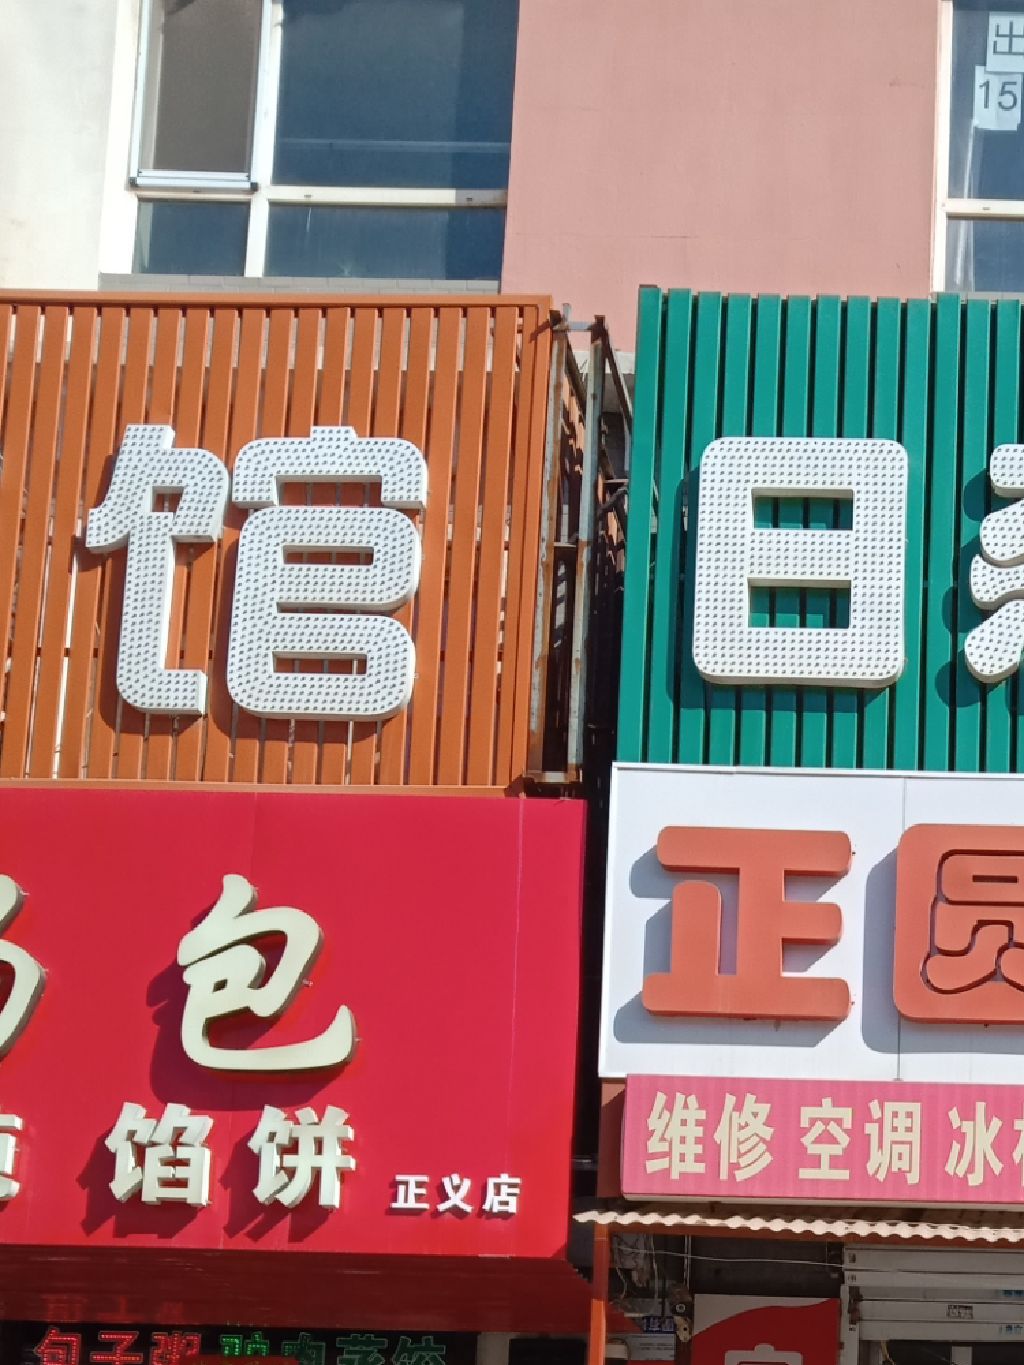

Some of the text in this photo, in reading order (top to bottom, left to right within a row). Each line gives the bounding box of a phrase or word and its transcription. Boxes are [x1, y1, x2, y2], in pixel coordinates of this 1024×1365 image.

[978, 81, 1018, 112] 15
[86, 425, 427, 721] 馆
[0, 873, 358, 1072] 包
[0, 1100, 356, 1210] 馅饼
[645, 1091, 775, 1183] 维修
[798, 1097, 922, 1186] 空调
[390, 1173, 522, 1215] 正义店
